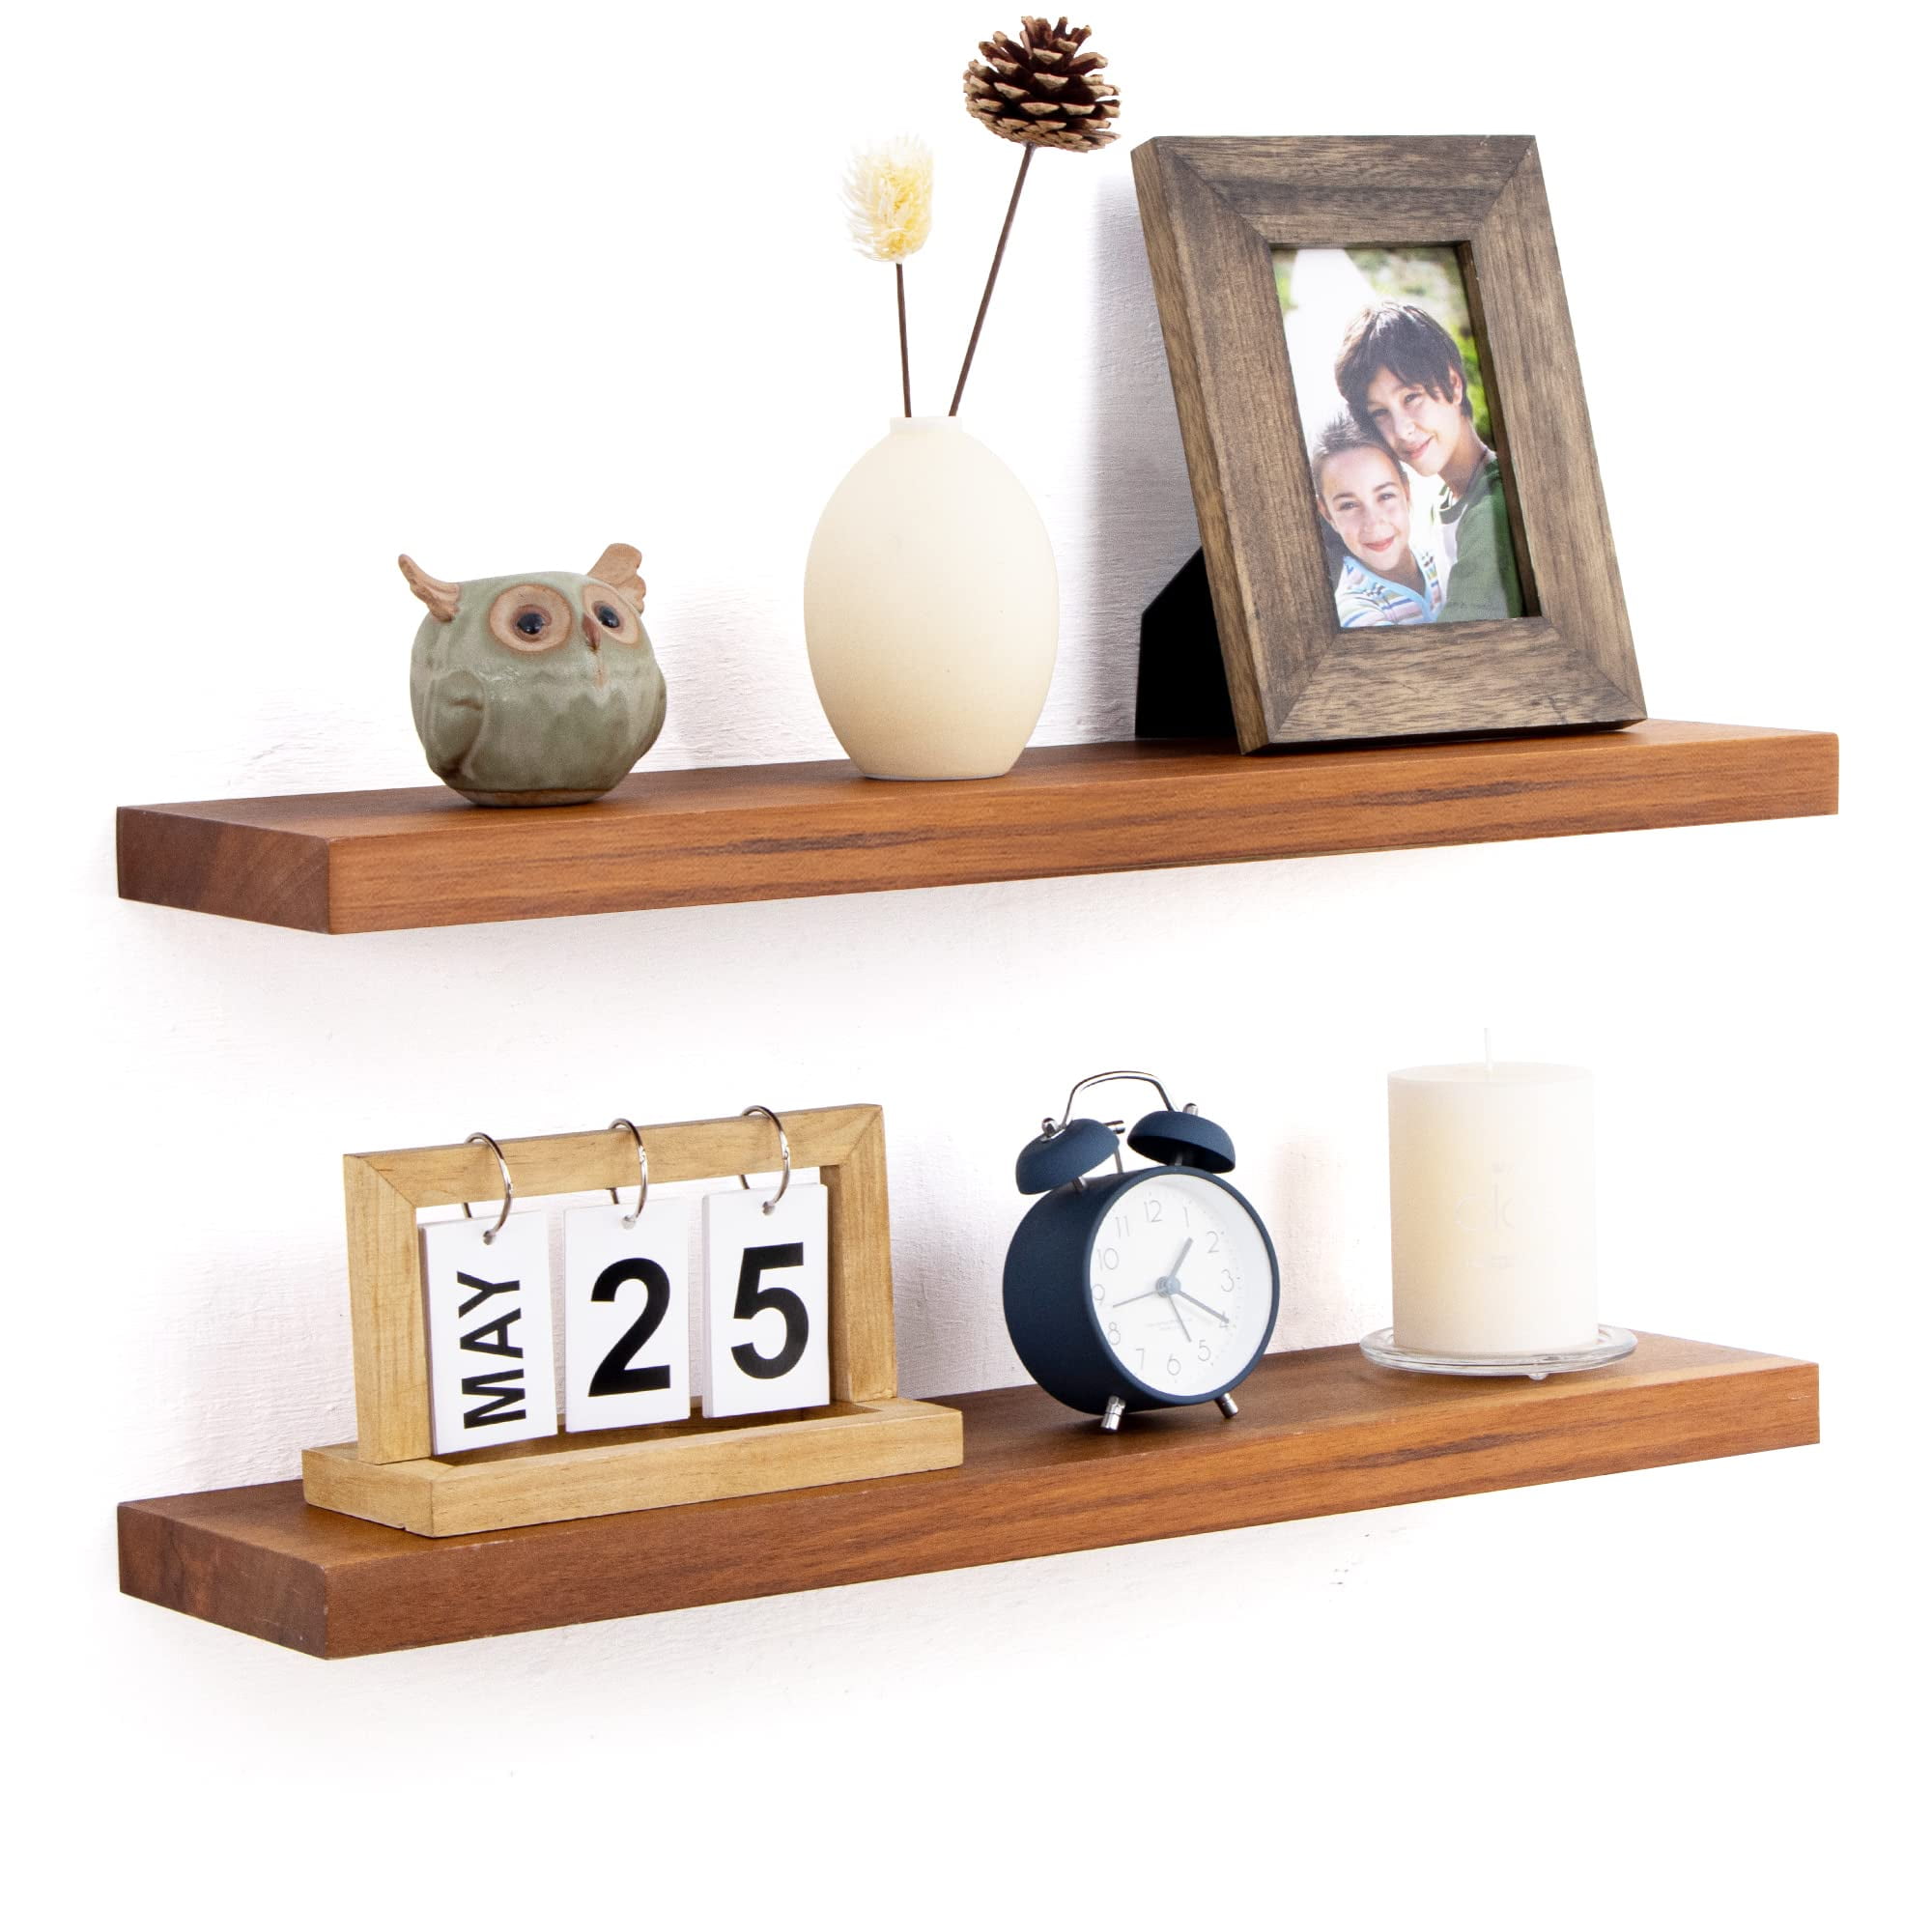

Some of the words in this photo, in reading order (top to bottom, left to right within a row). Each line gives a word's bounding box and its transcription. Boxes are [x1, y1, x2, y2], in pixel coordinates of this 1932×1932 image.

[1143, 1200, 1162, 1222] 12
[1116, 1216, 1130, 1238] 11
[1208, 1231, 1219, 1253] 2
[1097, 1248, 1120, 1270] 10
[1221, 1269, 1234, 1293] 3
[1093, 1284, 1105, 1305] 9
[457, 1271, 526, 1430] MAY
[588, 1257, 670, 1398] 2
[730, 1241, 810, 1379] 5
[1108, 1322, 1121, 1345] 8
[1136, 1349, 1145, 1370] 7
[1198, 1340, 1210, 1362] 5
[1167, 1355, 1180, 1376] 6
